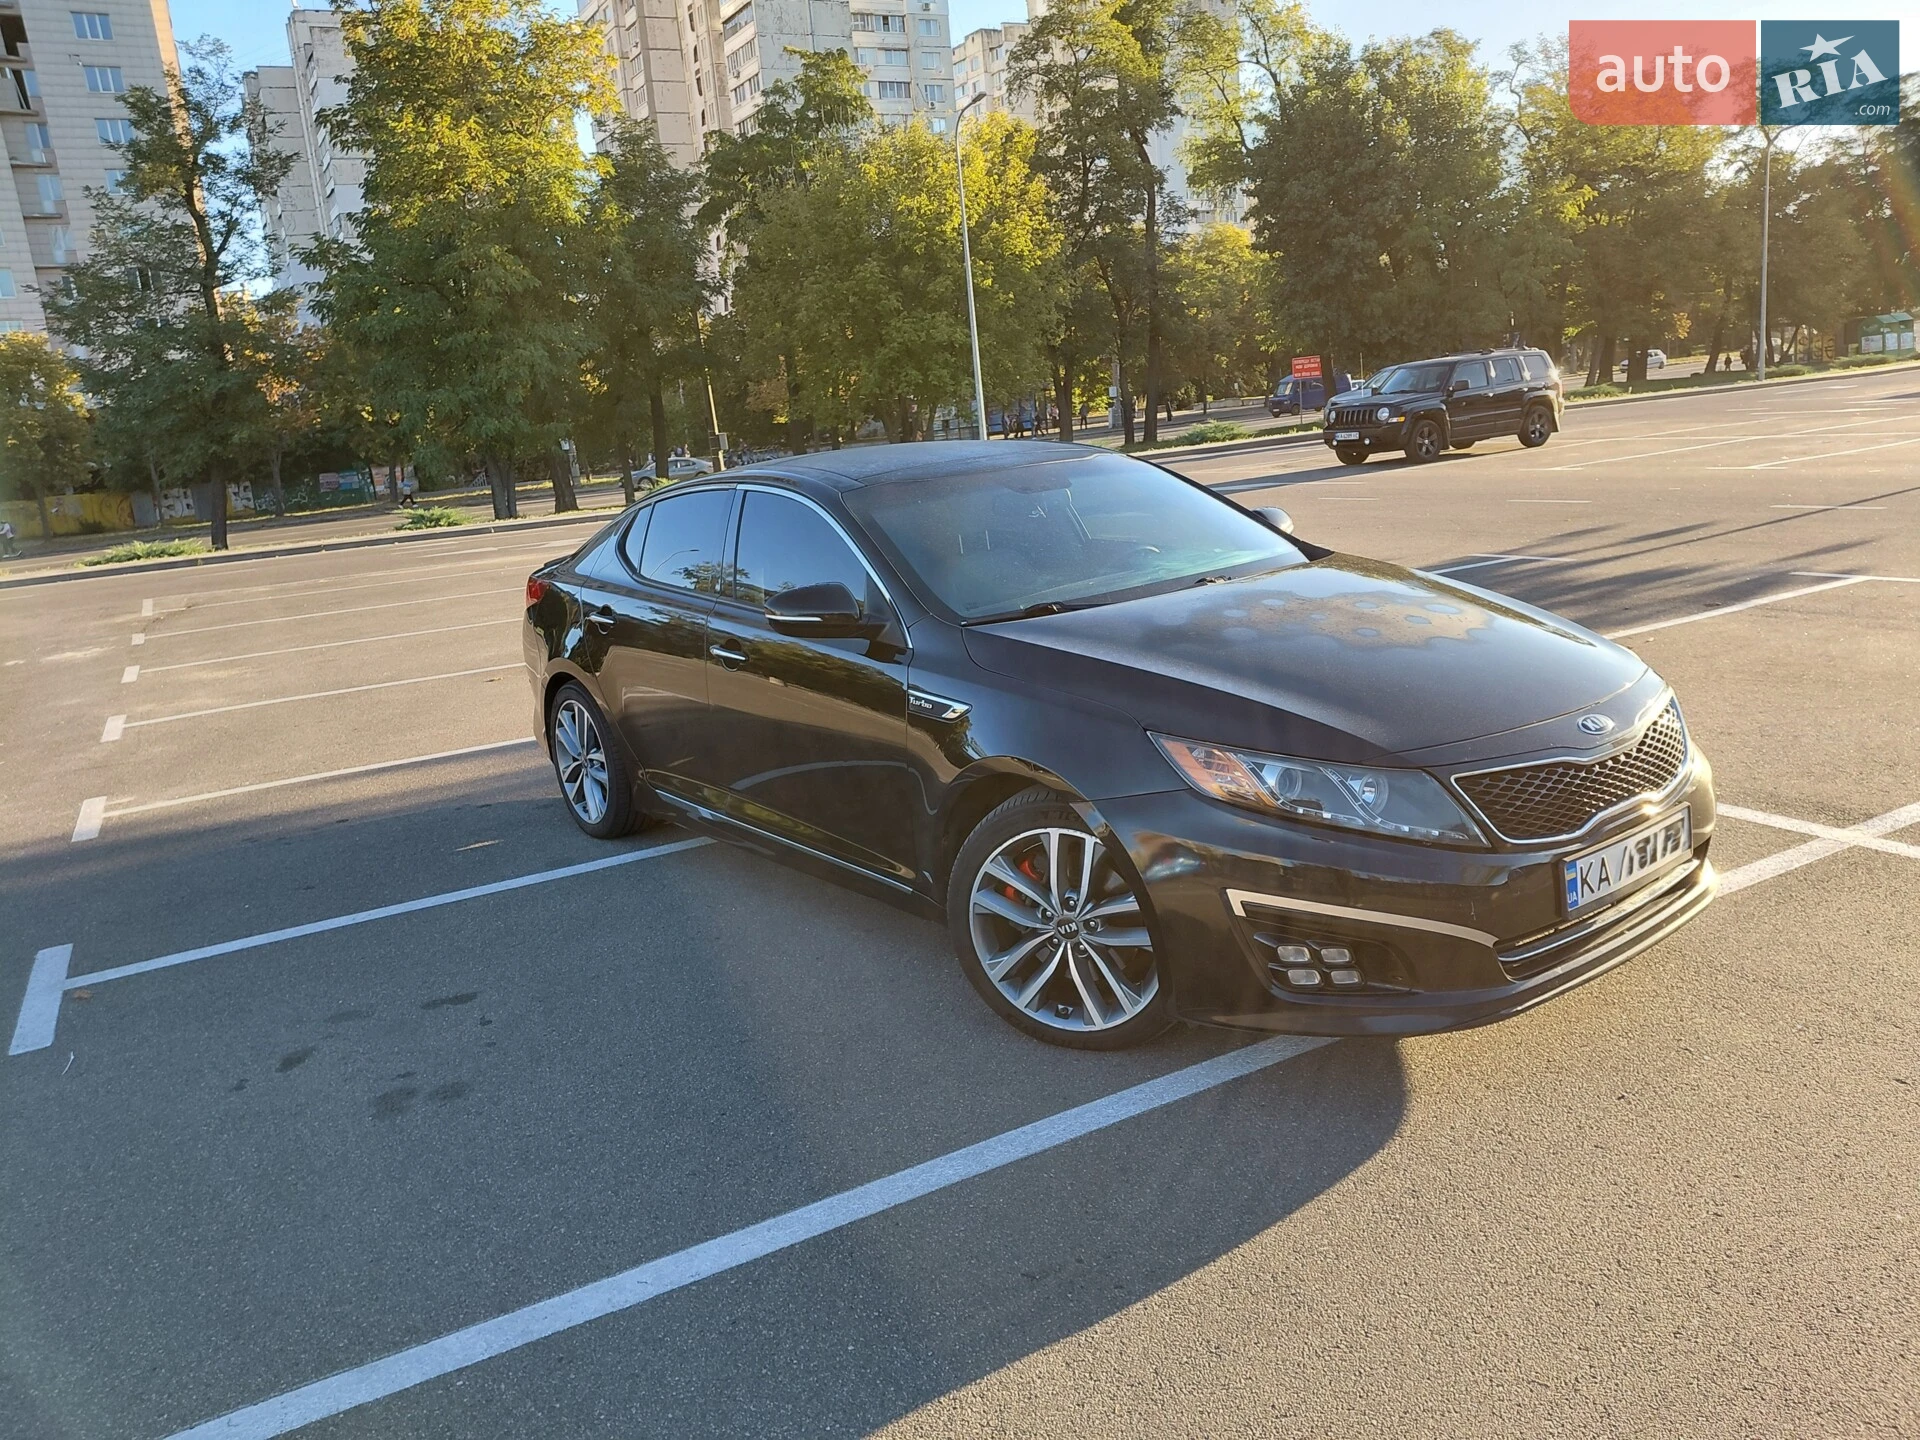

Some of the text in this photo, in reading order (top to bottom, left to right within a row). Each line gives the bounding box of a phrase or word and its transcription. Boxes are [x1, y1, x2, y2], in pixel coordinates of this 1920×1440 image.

[909, 697, 932, 709] Turbo
[1580, 857, 1611, 898] KA
[1567, 894, 1578, 904] UA
[1058, 923, 1077, 935] KIA
